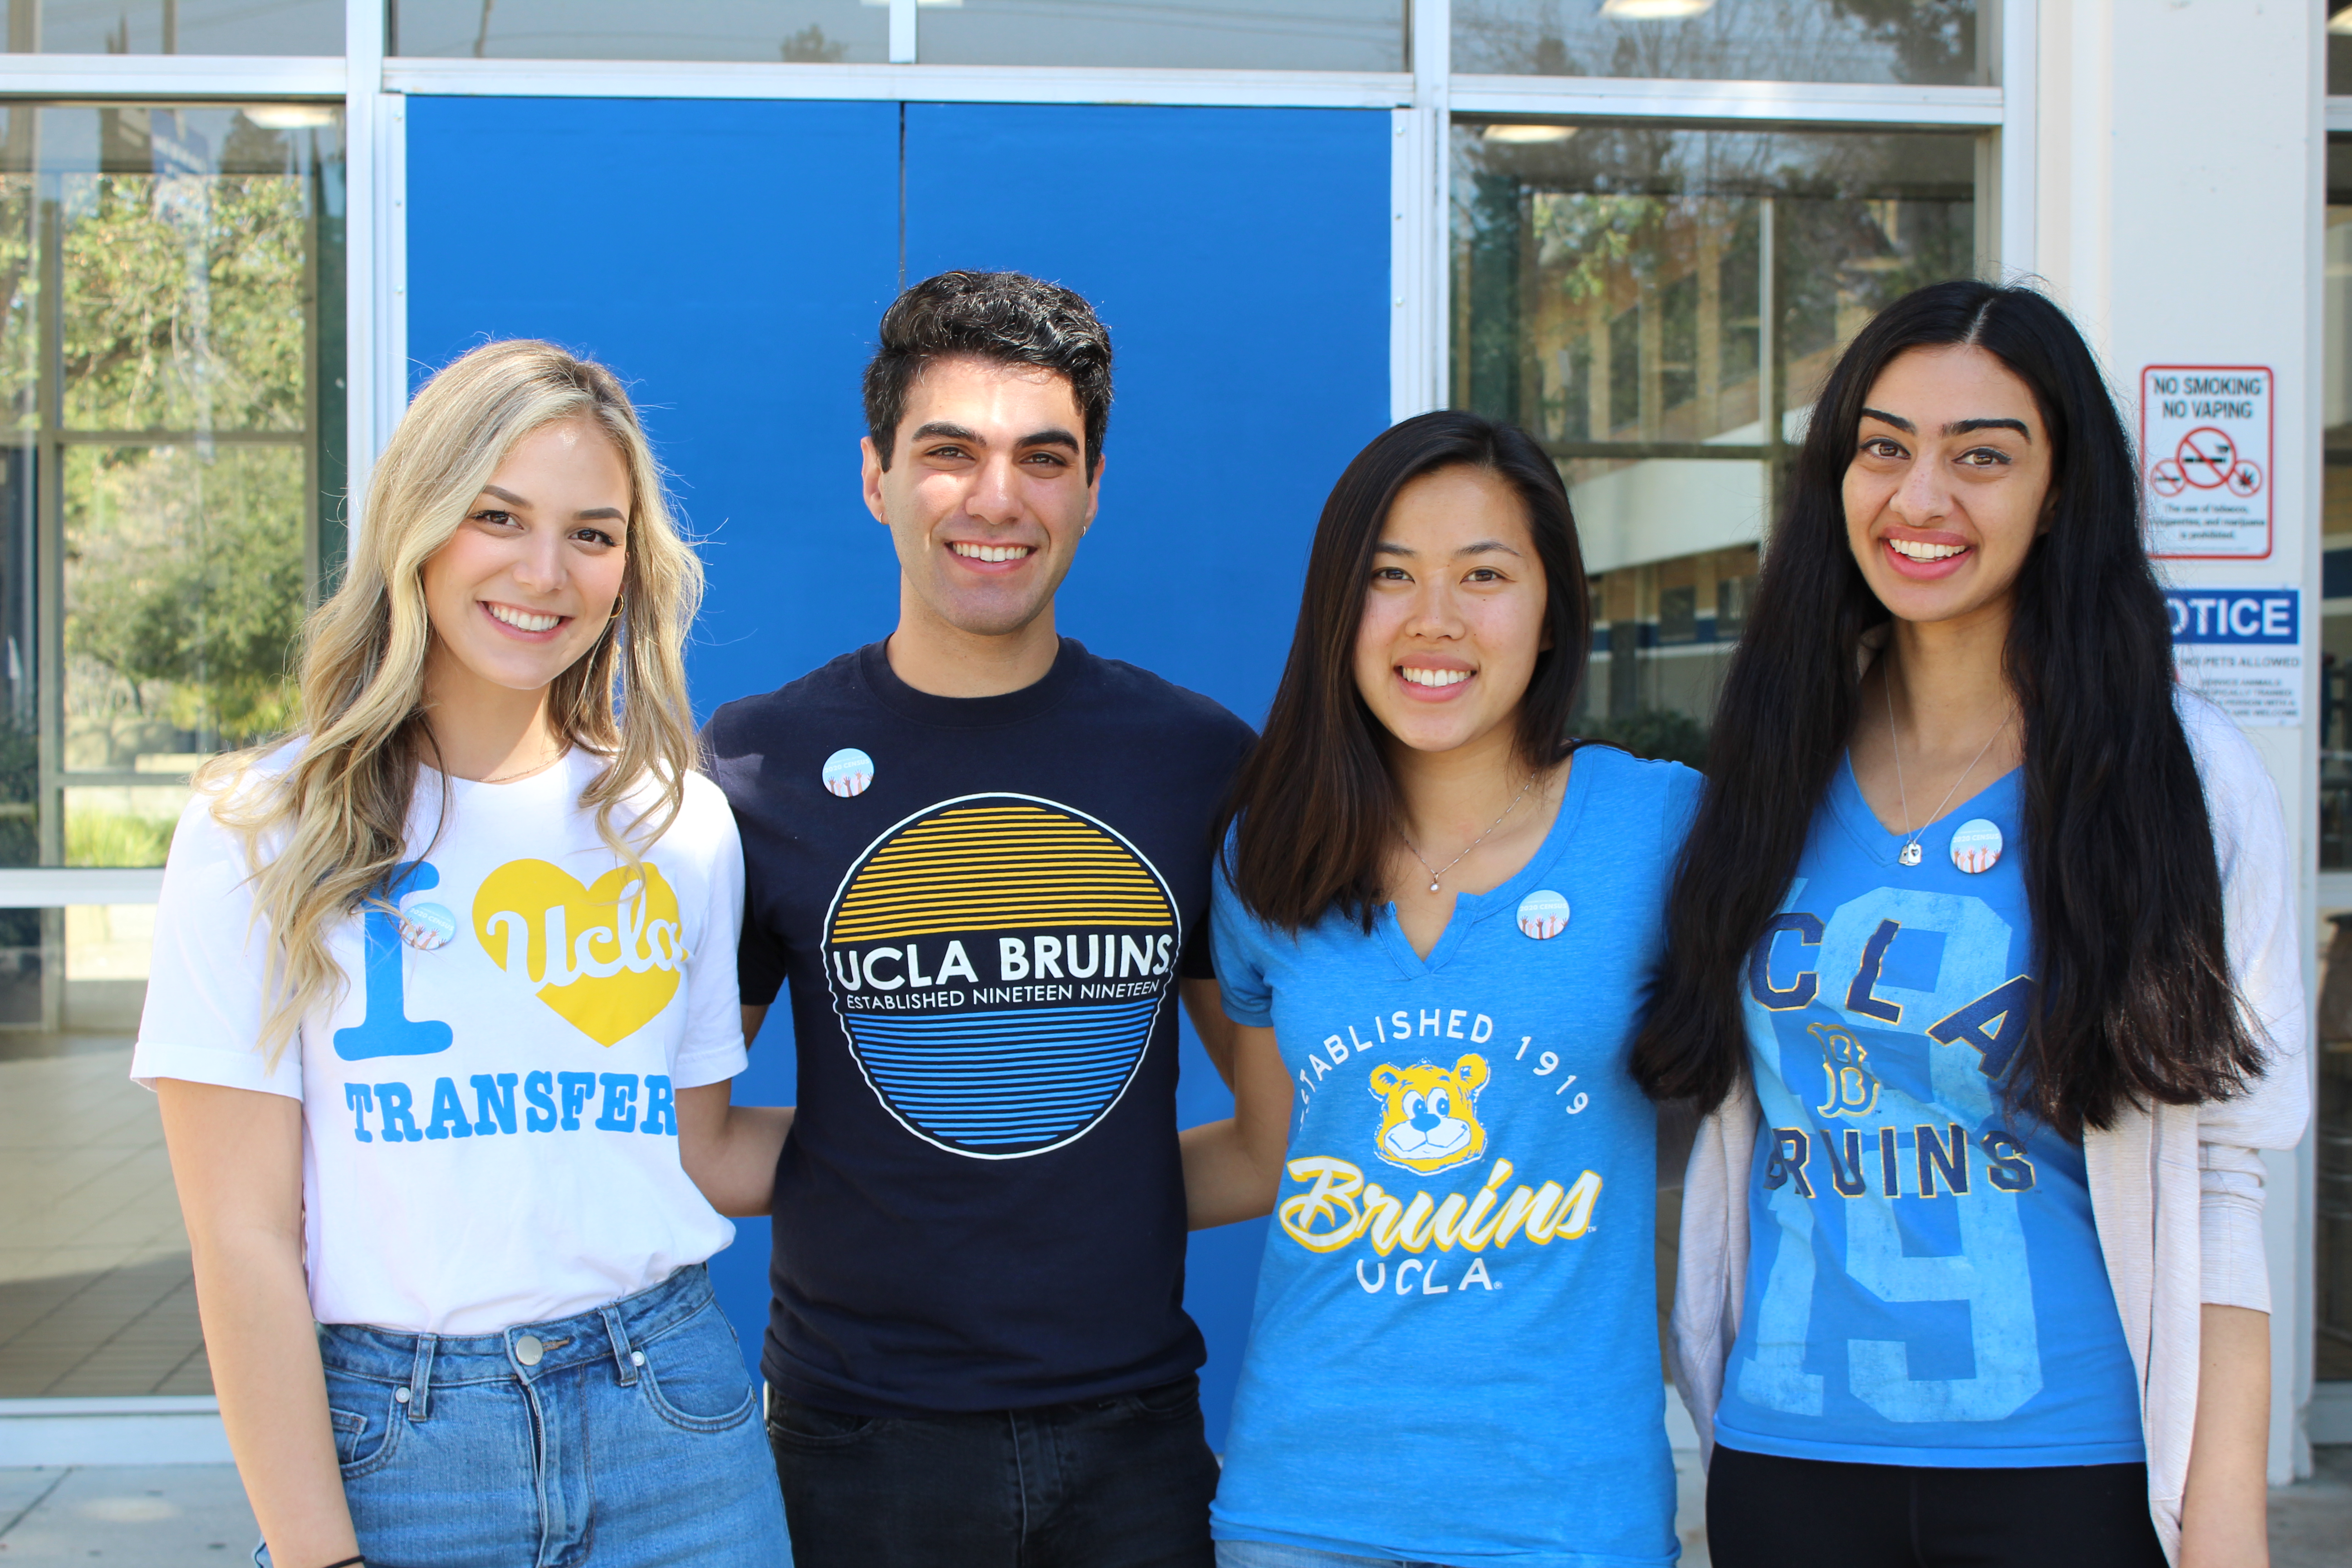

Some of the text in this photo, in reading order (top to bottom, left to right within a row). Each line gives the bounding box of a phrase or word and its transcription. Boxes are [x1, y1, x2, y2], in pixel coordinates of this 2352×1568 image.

[2154, 377, 2261, 395] NO SMOKING
[2162, 400, 2253, 419] NO VAPING
[2163, 597, 2291, 637] OTICE
[2202, 657, 2234, 666] PETS
[2236, 657, 2299, 667] ALLOWED
[824, 764, 842, 774] 2020
[843, 758, 870, 769] CENSUS
[1952, 835, 1971, 843] 2020
[410, 907, 428, 918] 2020
[428, 916, 455, 931] CENSUS
[333, 861, 453, 1061] I
[833, 934, 1173, 991] UCLA BRUINS
[846, 979, 1160, 1009] ESTABLISHED NINETEEN NINETEEN
[1748, 912, 2038, 1081] CLA
[1514, 1035, 1588, 1115] 1919
[343, 1070, 678, 1142] TRANSFER
[1278, 1155, 1602, 1256] Bruins
[1356, 1257, 1493, 1296] UCLA
